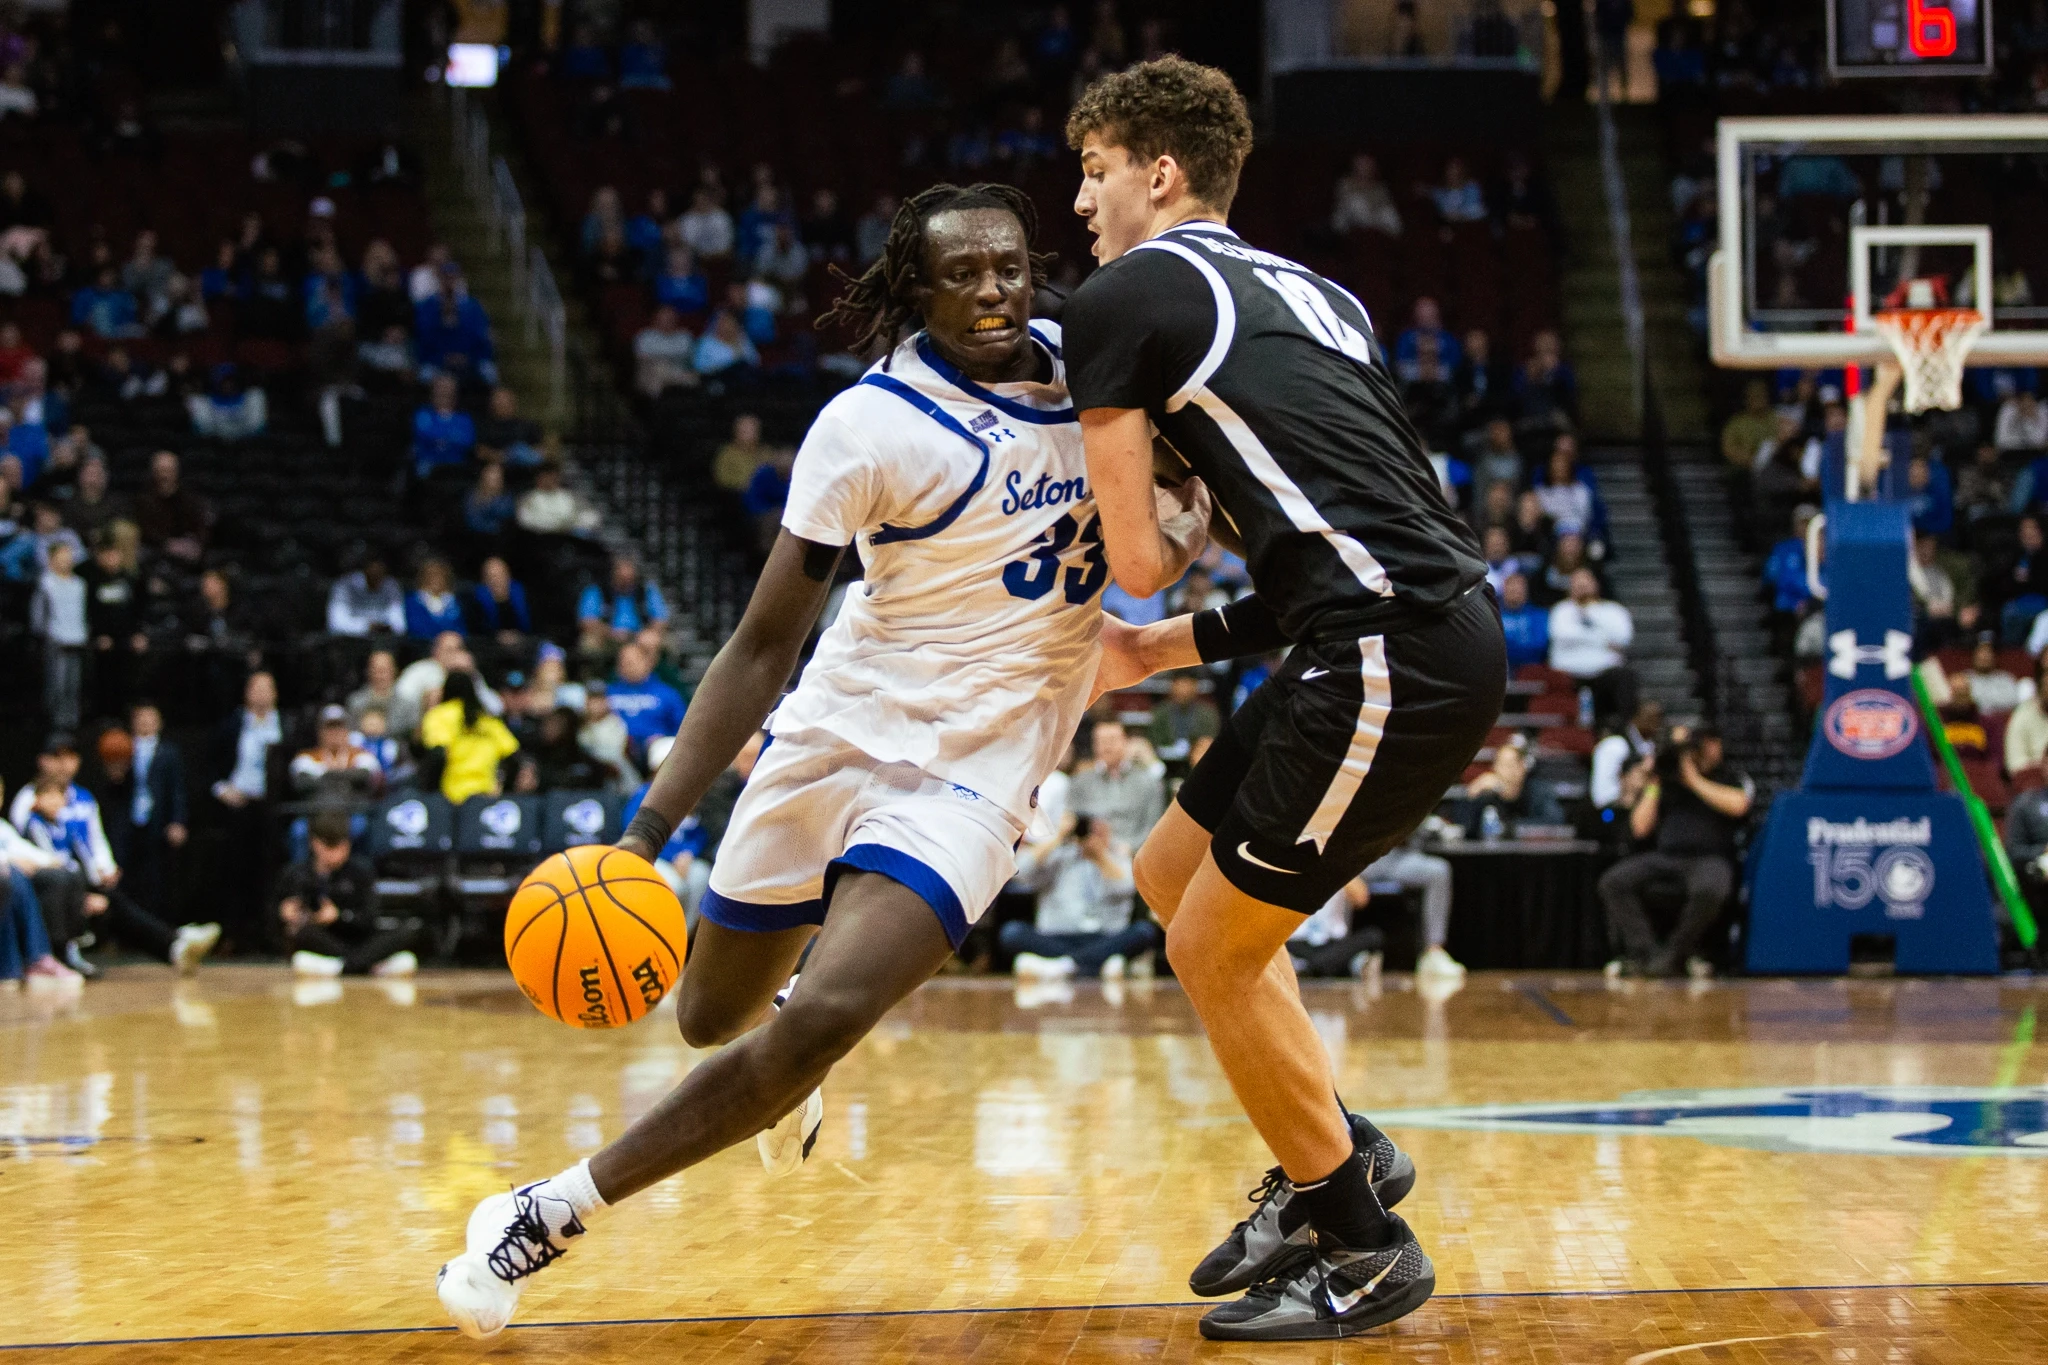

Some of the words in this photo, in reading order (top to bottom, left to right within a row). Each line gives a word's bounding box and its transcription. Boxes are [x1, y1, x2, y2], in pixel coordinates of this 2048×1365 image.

[1002, 470, 1087, 516] Seton
[1002, 511, 1108, 605] 33
[631, 957, 664, 1010] CAA
